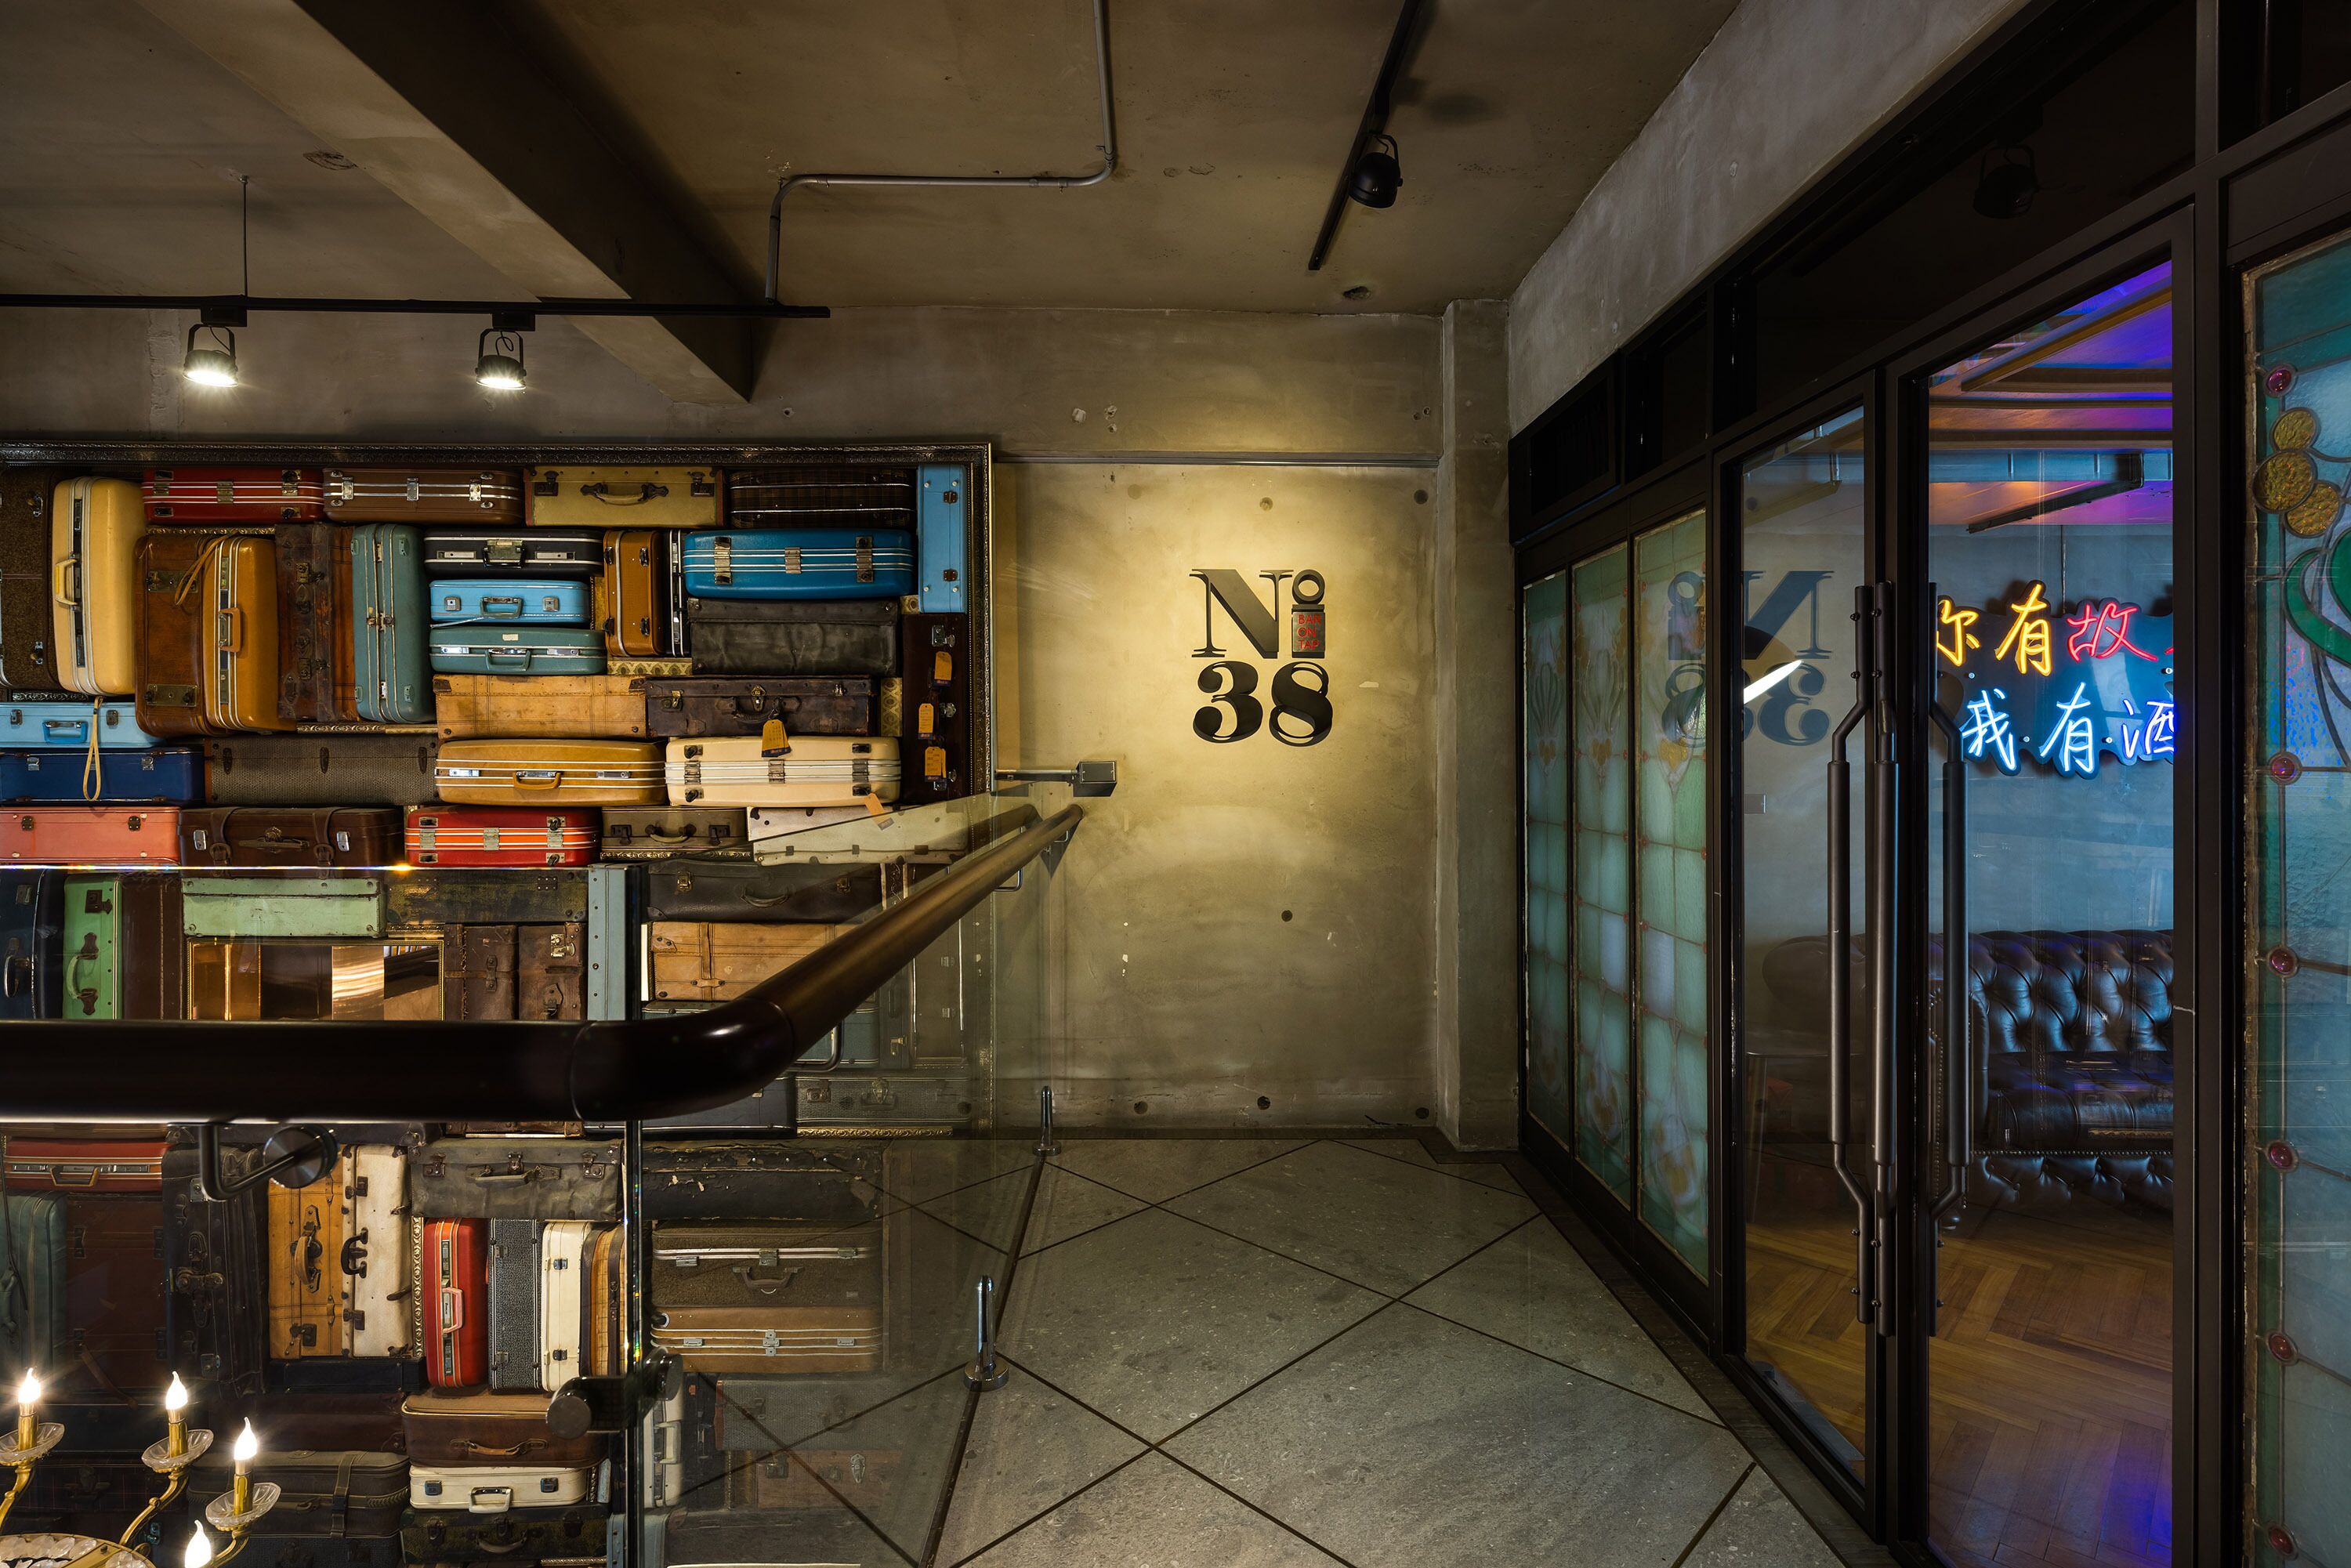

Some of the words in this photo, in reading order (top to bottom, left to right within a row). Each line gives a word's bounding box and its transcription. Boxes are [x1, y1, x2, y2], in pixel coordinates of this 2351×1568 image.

[1298, 614, 1321, 625] BAR
[1298, 627, 1316, 637] ON
[1936, 584, 2173, 676] 你有故
[1297, 639, 1320, 650] TAP
[1193, 661, 1333, 747] 38
[1960, 682, 2174, 773] 我有酒
